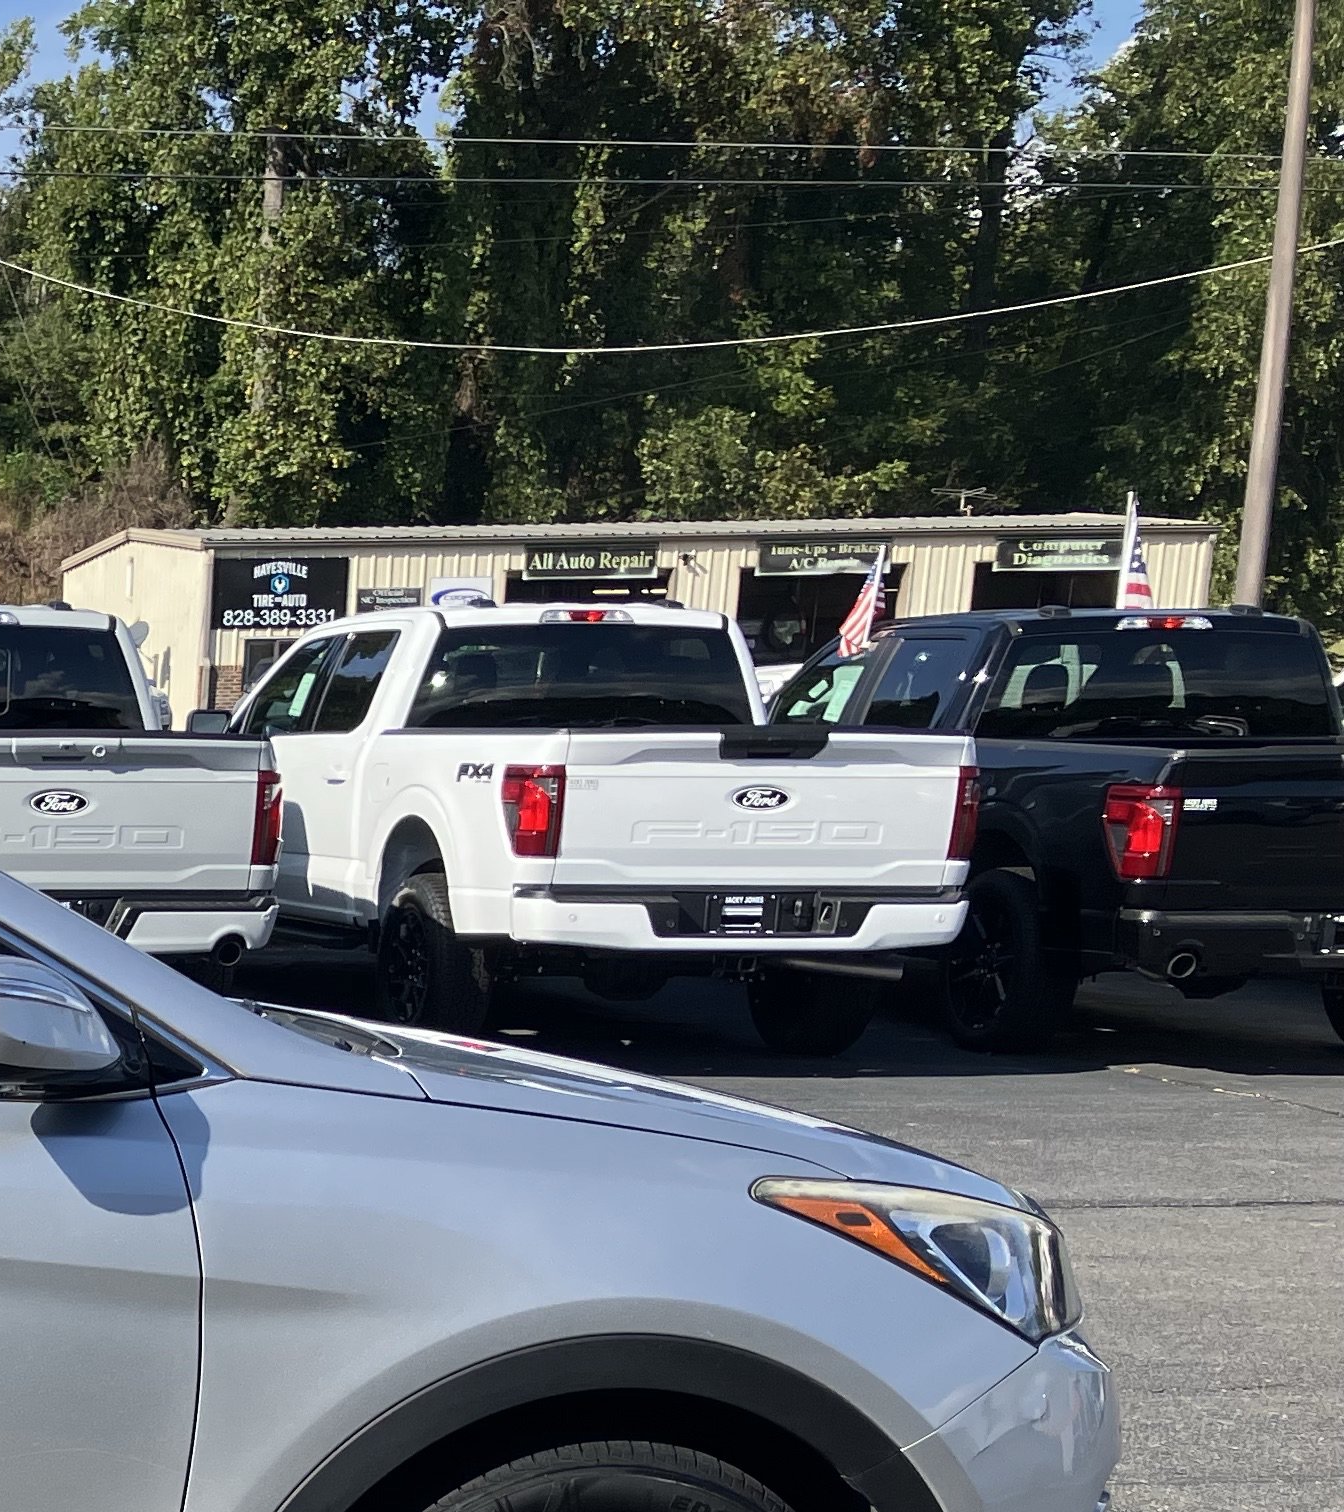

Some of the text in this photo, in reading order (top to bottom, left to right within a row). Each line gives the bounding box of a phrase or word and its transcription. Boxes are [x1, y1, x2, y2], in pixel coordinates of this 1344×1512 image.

[1018, 541, 1106, 554] Computer
[529, 551, 653, 573] All Auto Repair
[789, 558, 814, 569] A/C
[1013, 553, 1110, 567] Diagnostics
[253, 561, 309, 579] HAYESVILLE
[252, 594, 274, 607] TIRE
[281, 594, 307, 607] AUTO
[222, 608, 336, 626] 828-389-3331
[456, 763, 494, 783] FX4
[40, 794, 79, 811] Ford
[742, 790, 780, 806] Ford
[630, 819, 884, 845] F-150
